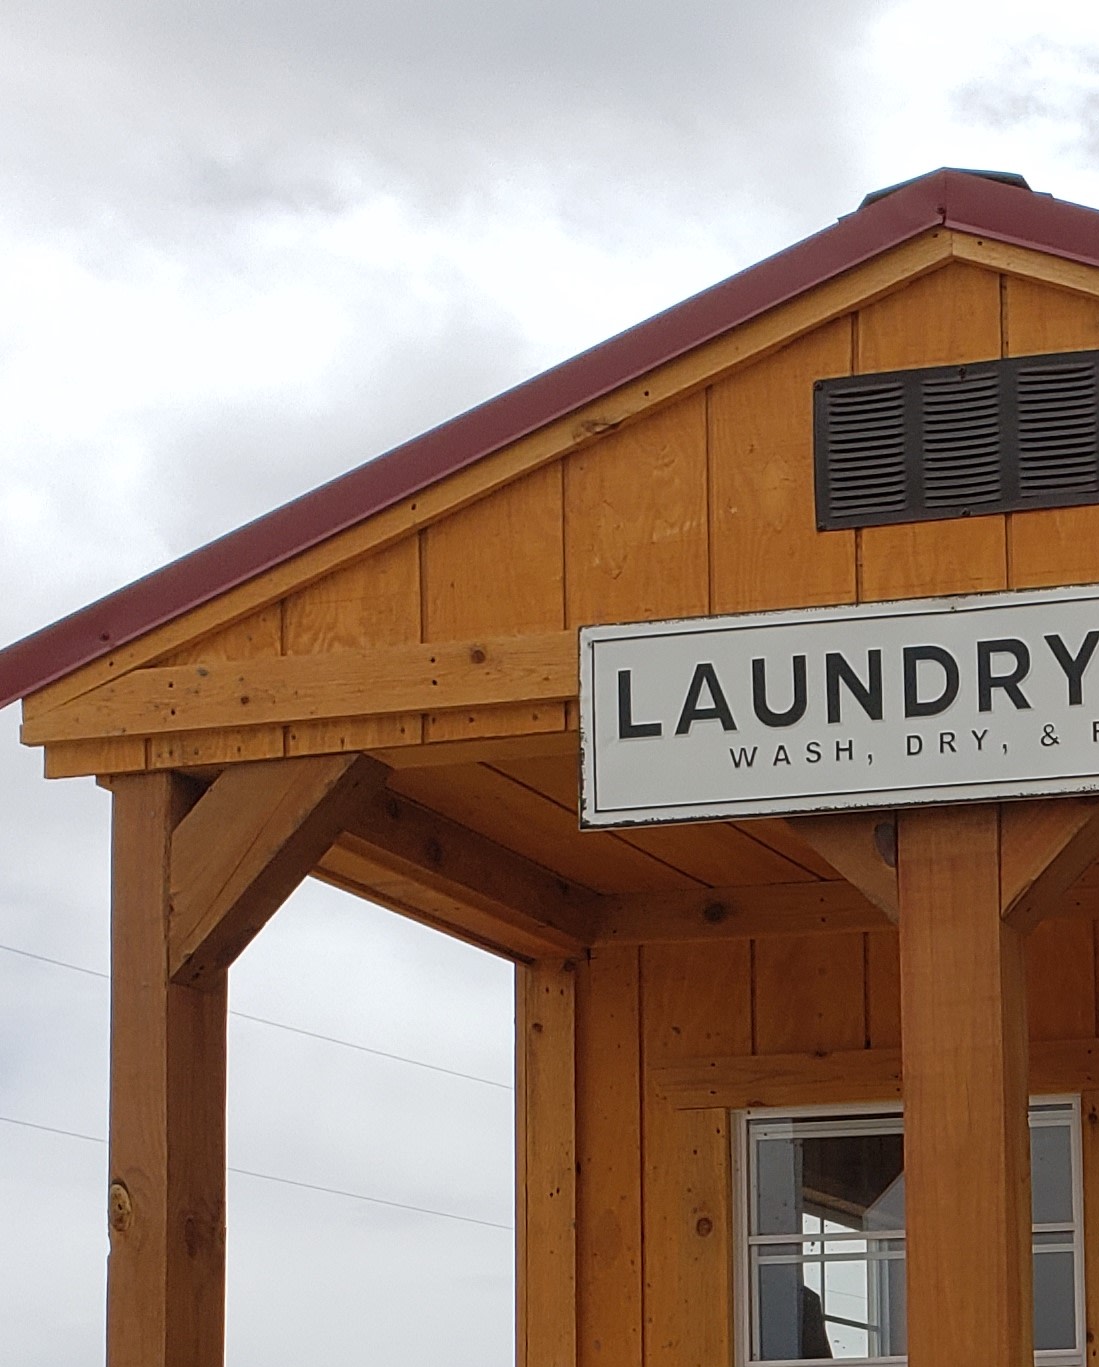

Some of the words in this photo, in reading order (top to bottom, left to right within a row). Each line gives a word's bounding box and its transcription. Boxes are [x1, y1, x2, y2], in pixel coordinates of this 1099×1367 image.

[729, 739, 876, 769] WASH,
[905, 728, 1010, 757] DRY,
[1039, 723, 1061, 748] &
